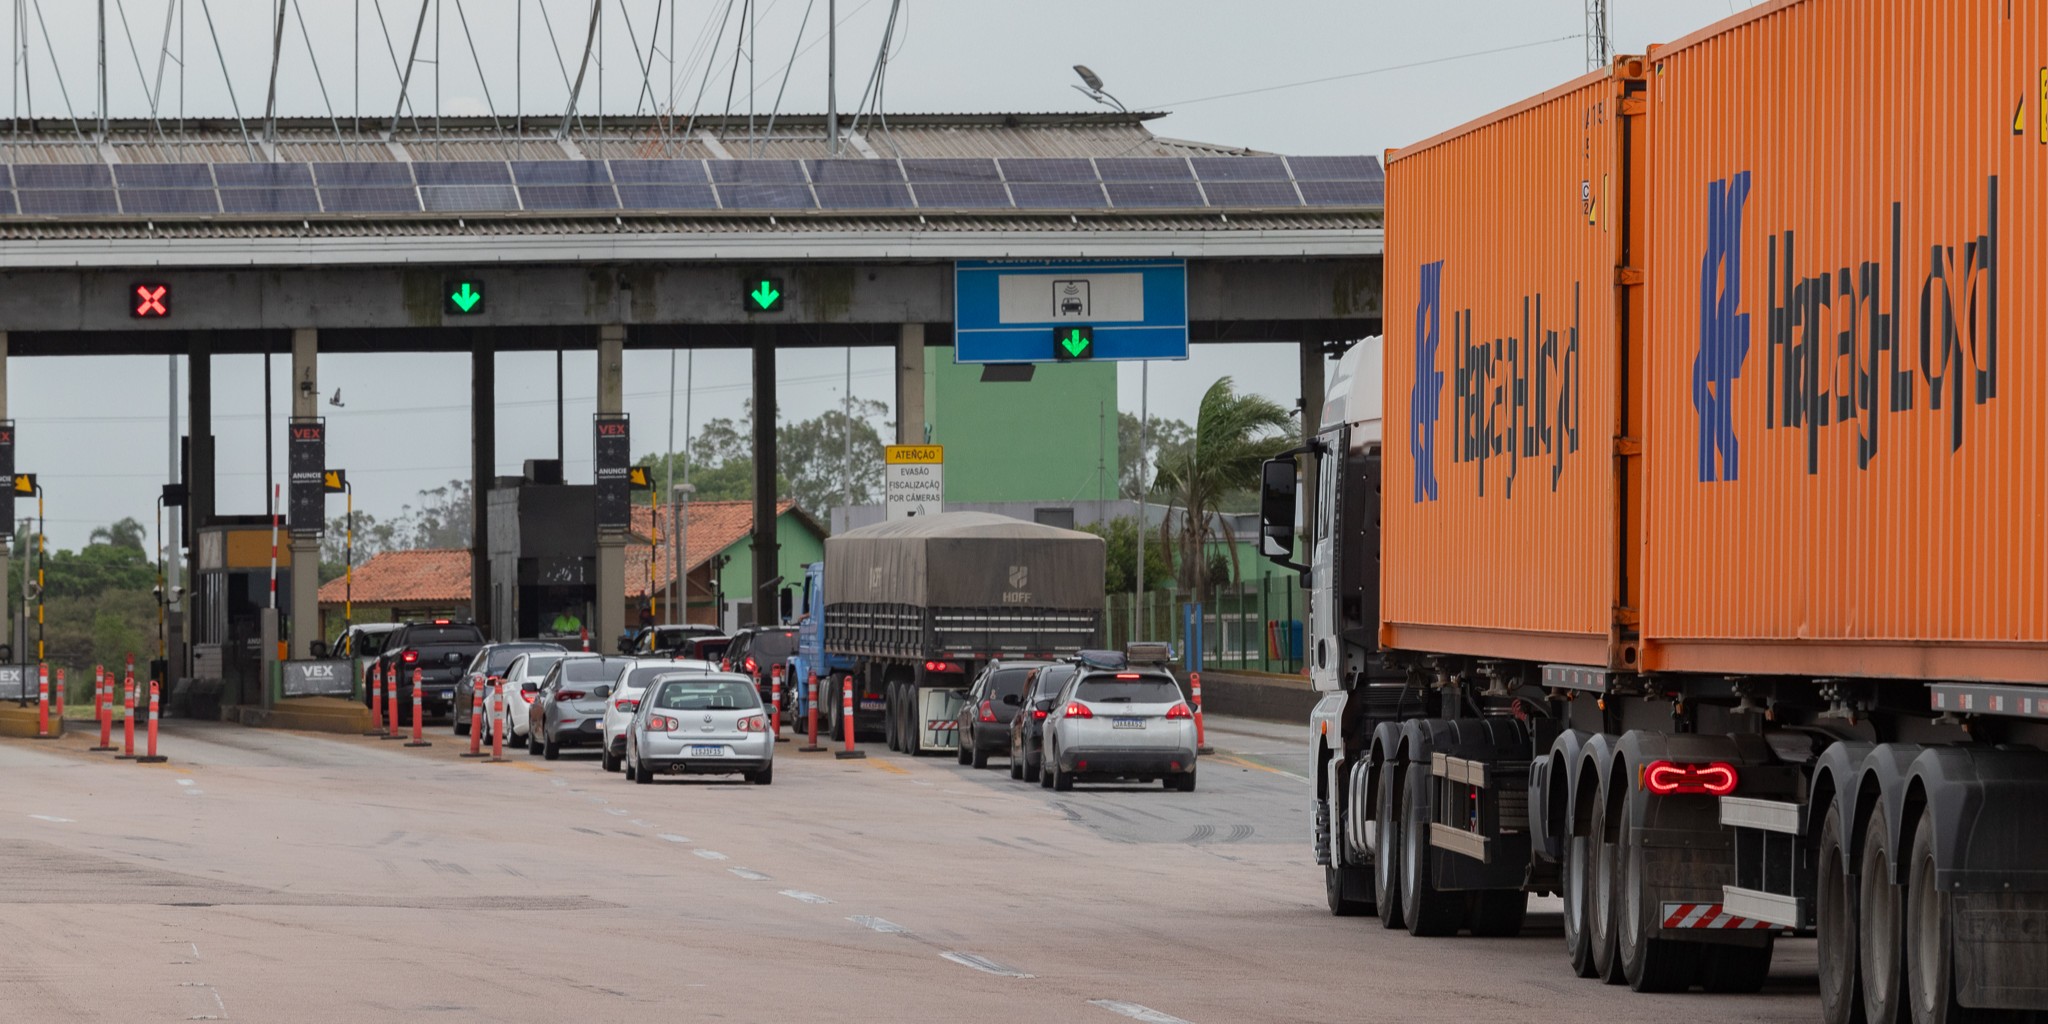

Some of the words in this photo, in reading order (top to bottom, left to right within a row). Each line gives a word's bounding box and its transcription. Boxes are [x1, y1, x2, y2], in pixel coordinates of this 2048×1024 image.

[1766, 175, 1998, 475] Hapag-Loyd
[293, 428, 321, 439] VEX
[598, 424, 625, 435] VEX
[292, 471, 322, 479] ANUNCIE
[598, 467, 628, 475] ANUNCIE
[889, 494, 904, 502] POR
[1003, 592, 1032, 603] HOFF
[0, 670, 20, 681] EX
[302, 665, 334, 677] VEX
